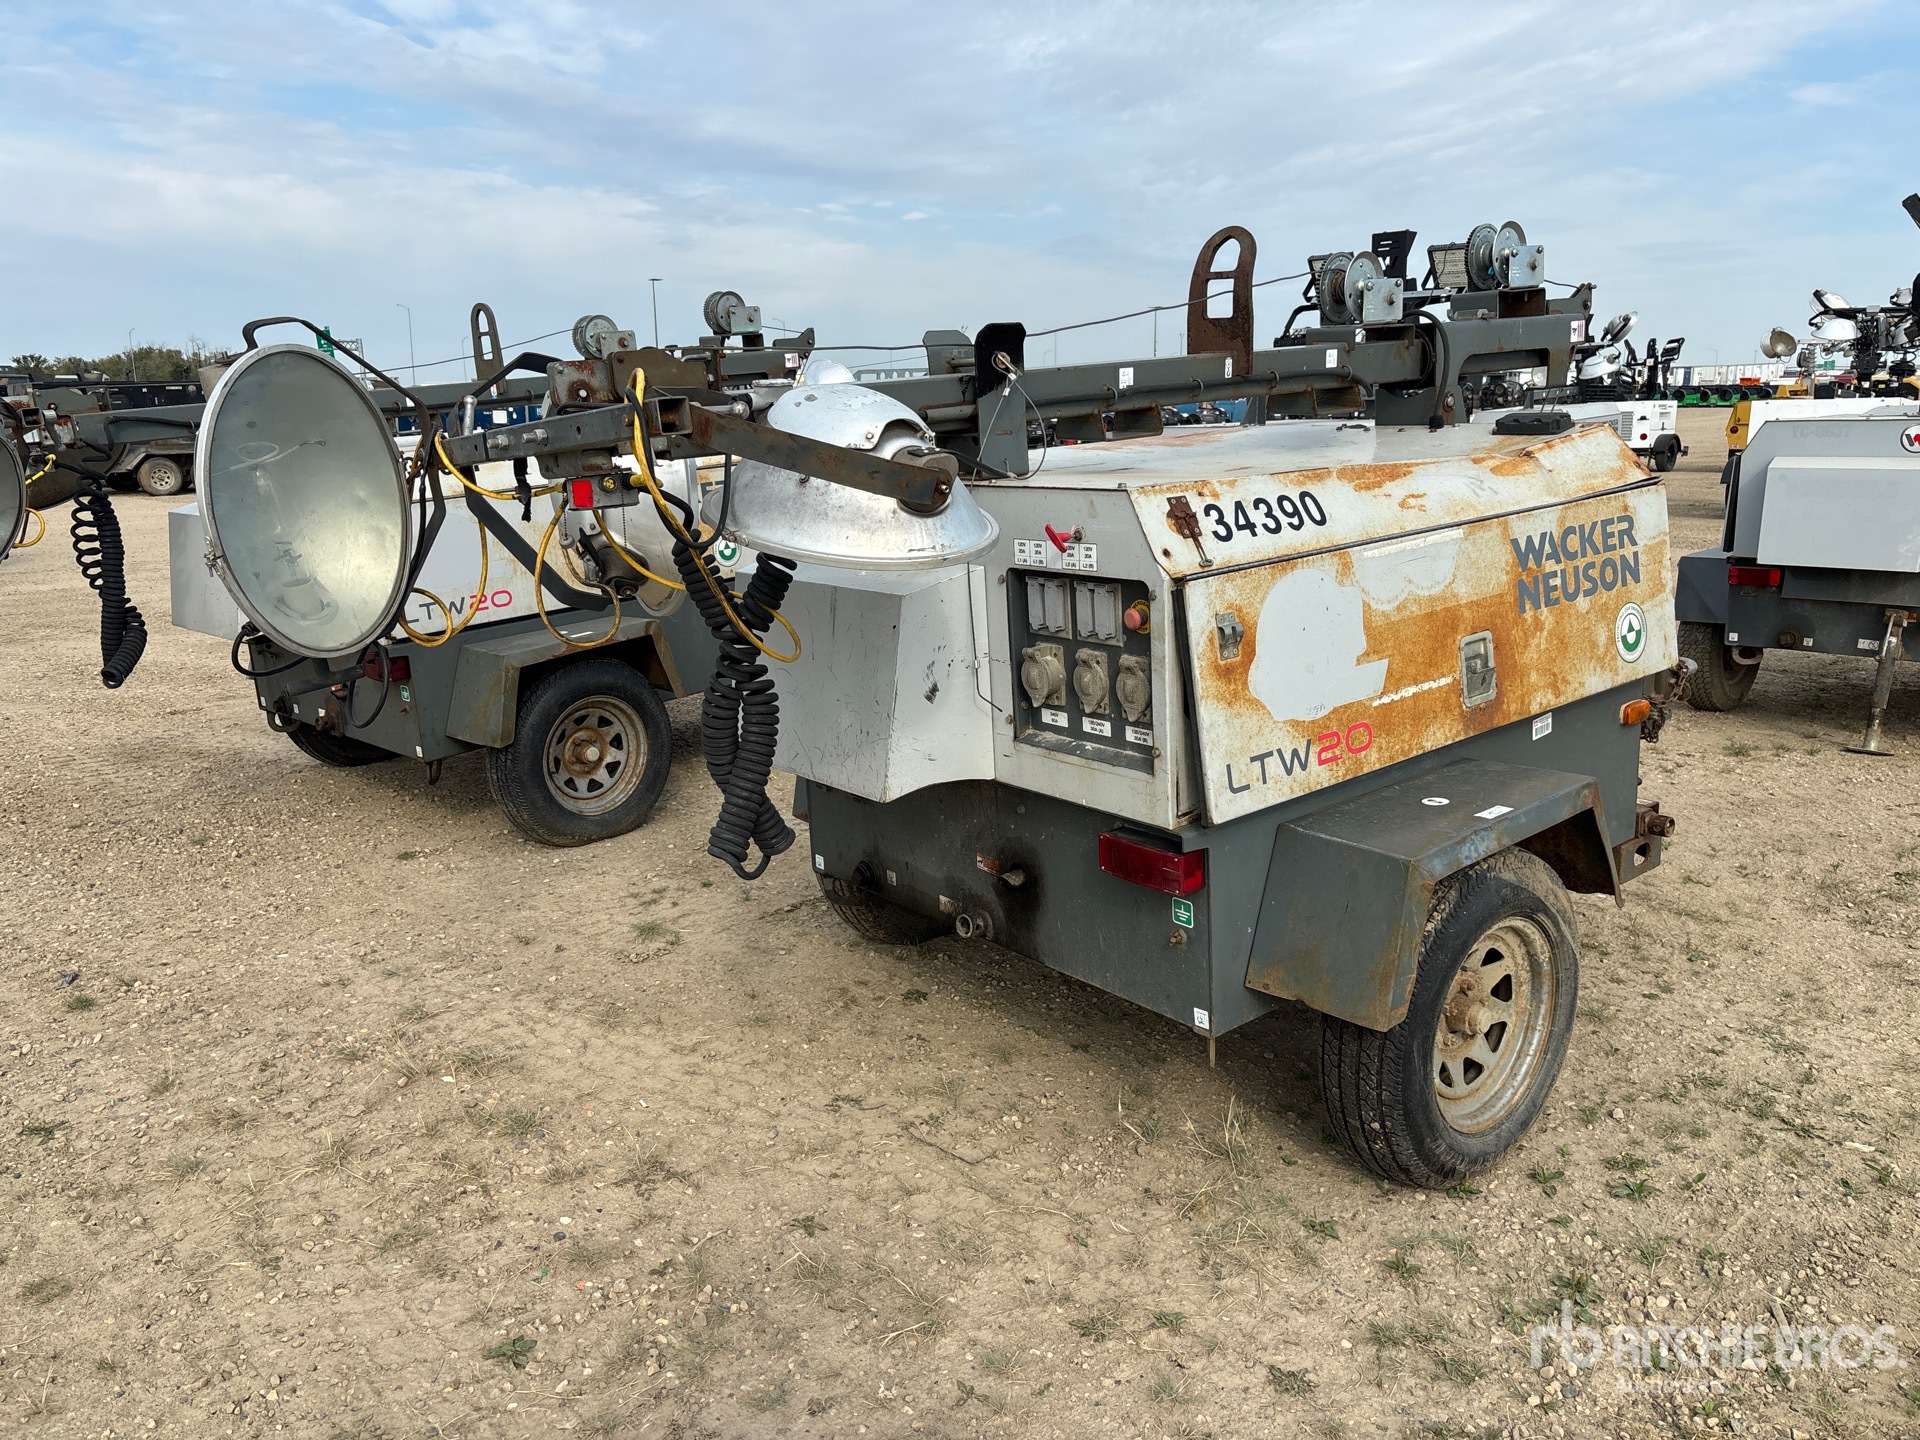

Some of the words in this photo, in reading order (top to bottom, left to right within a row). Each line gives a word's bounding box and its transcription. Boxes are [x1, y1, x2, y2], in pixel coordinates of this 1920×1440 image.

[1203, 490, 1327, 542] 34390
[1510, 515, 1638, 572] WACKER
[1517, 551, 1641, 615] NEUSON
[1226, 722, 1373, 794] LTW20
